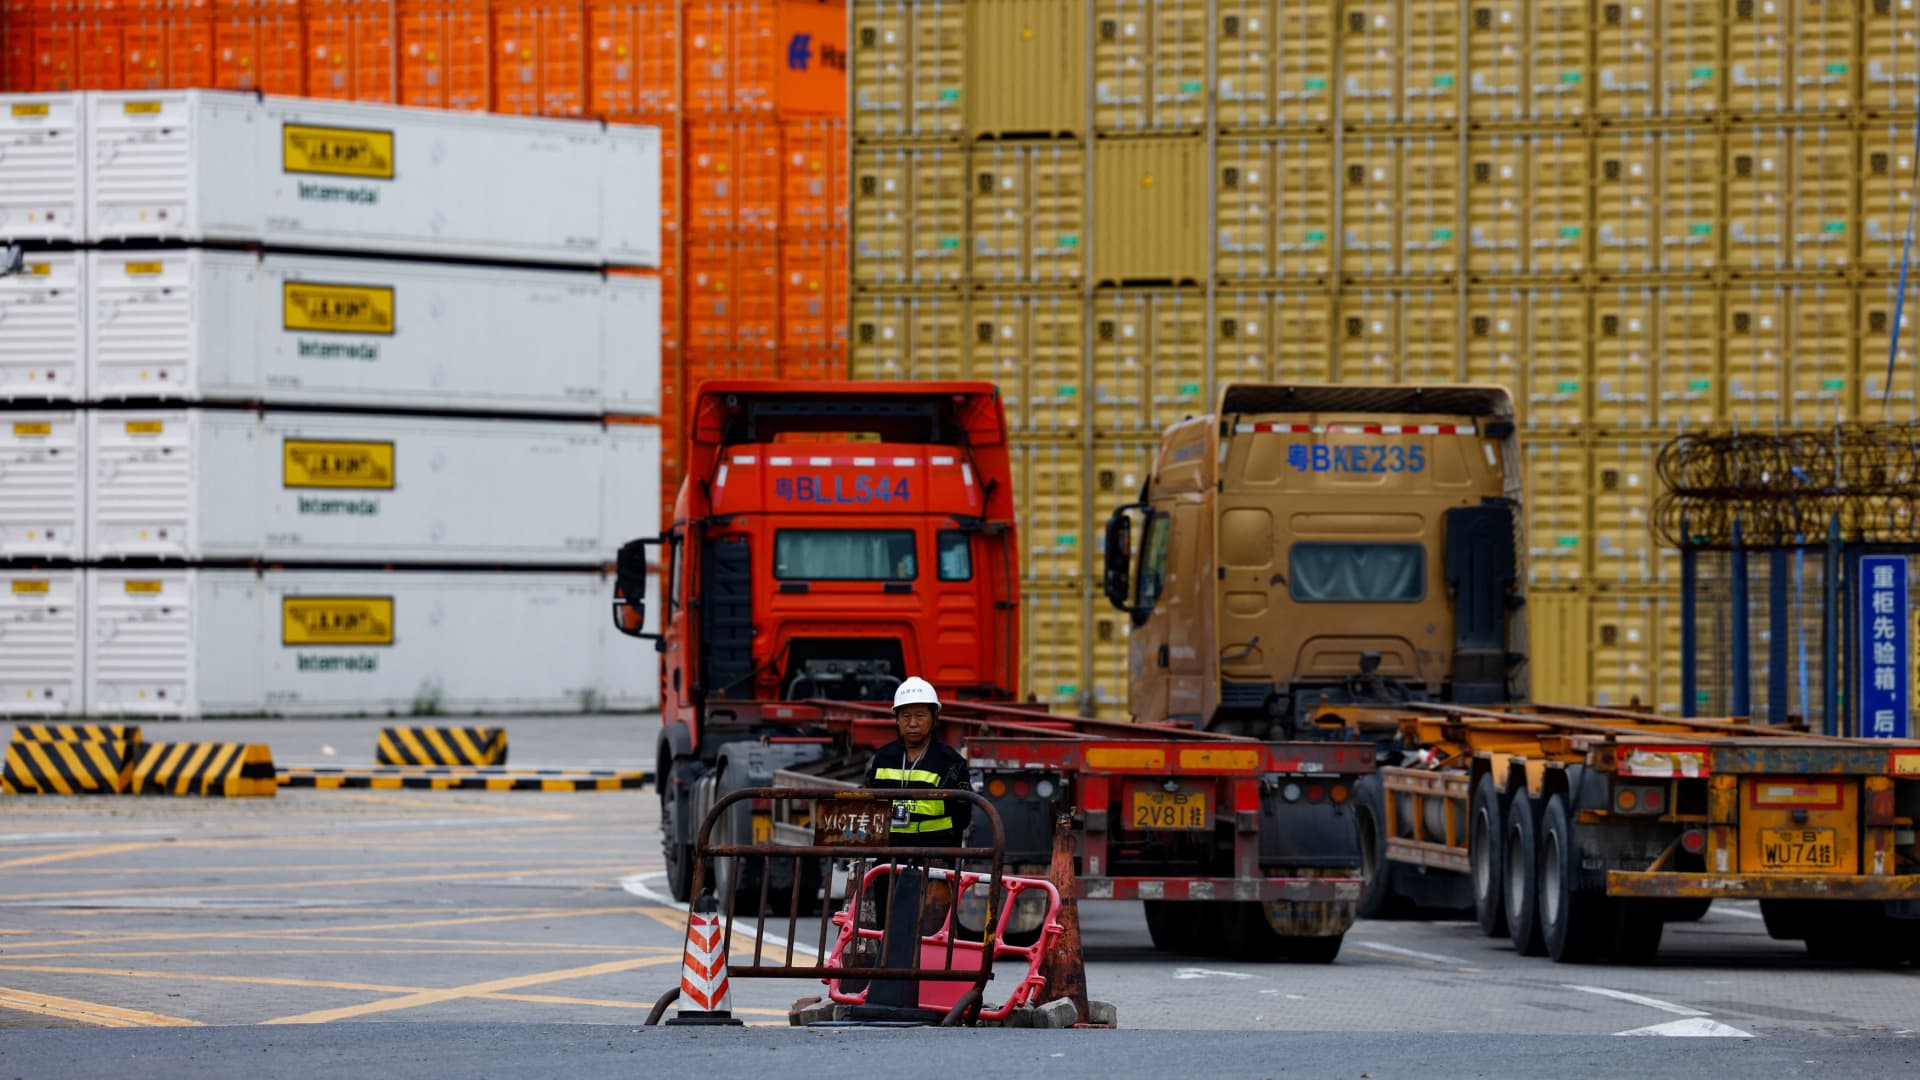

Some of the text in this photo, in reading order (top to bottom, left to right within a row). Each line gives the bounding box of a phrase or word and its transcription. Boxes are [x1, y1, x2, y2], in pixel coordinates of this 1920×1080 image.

[1871, 564, 1896, 738] 重柜先验箱,后
